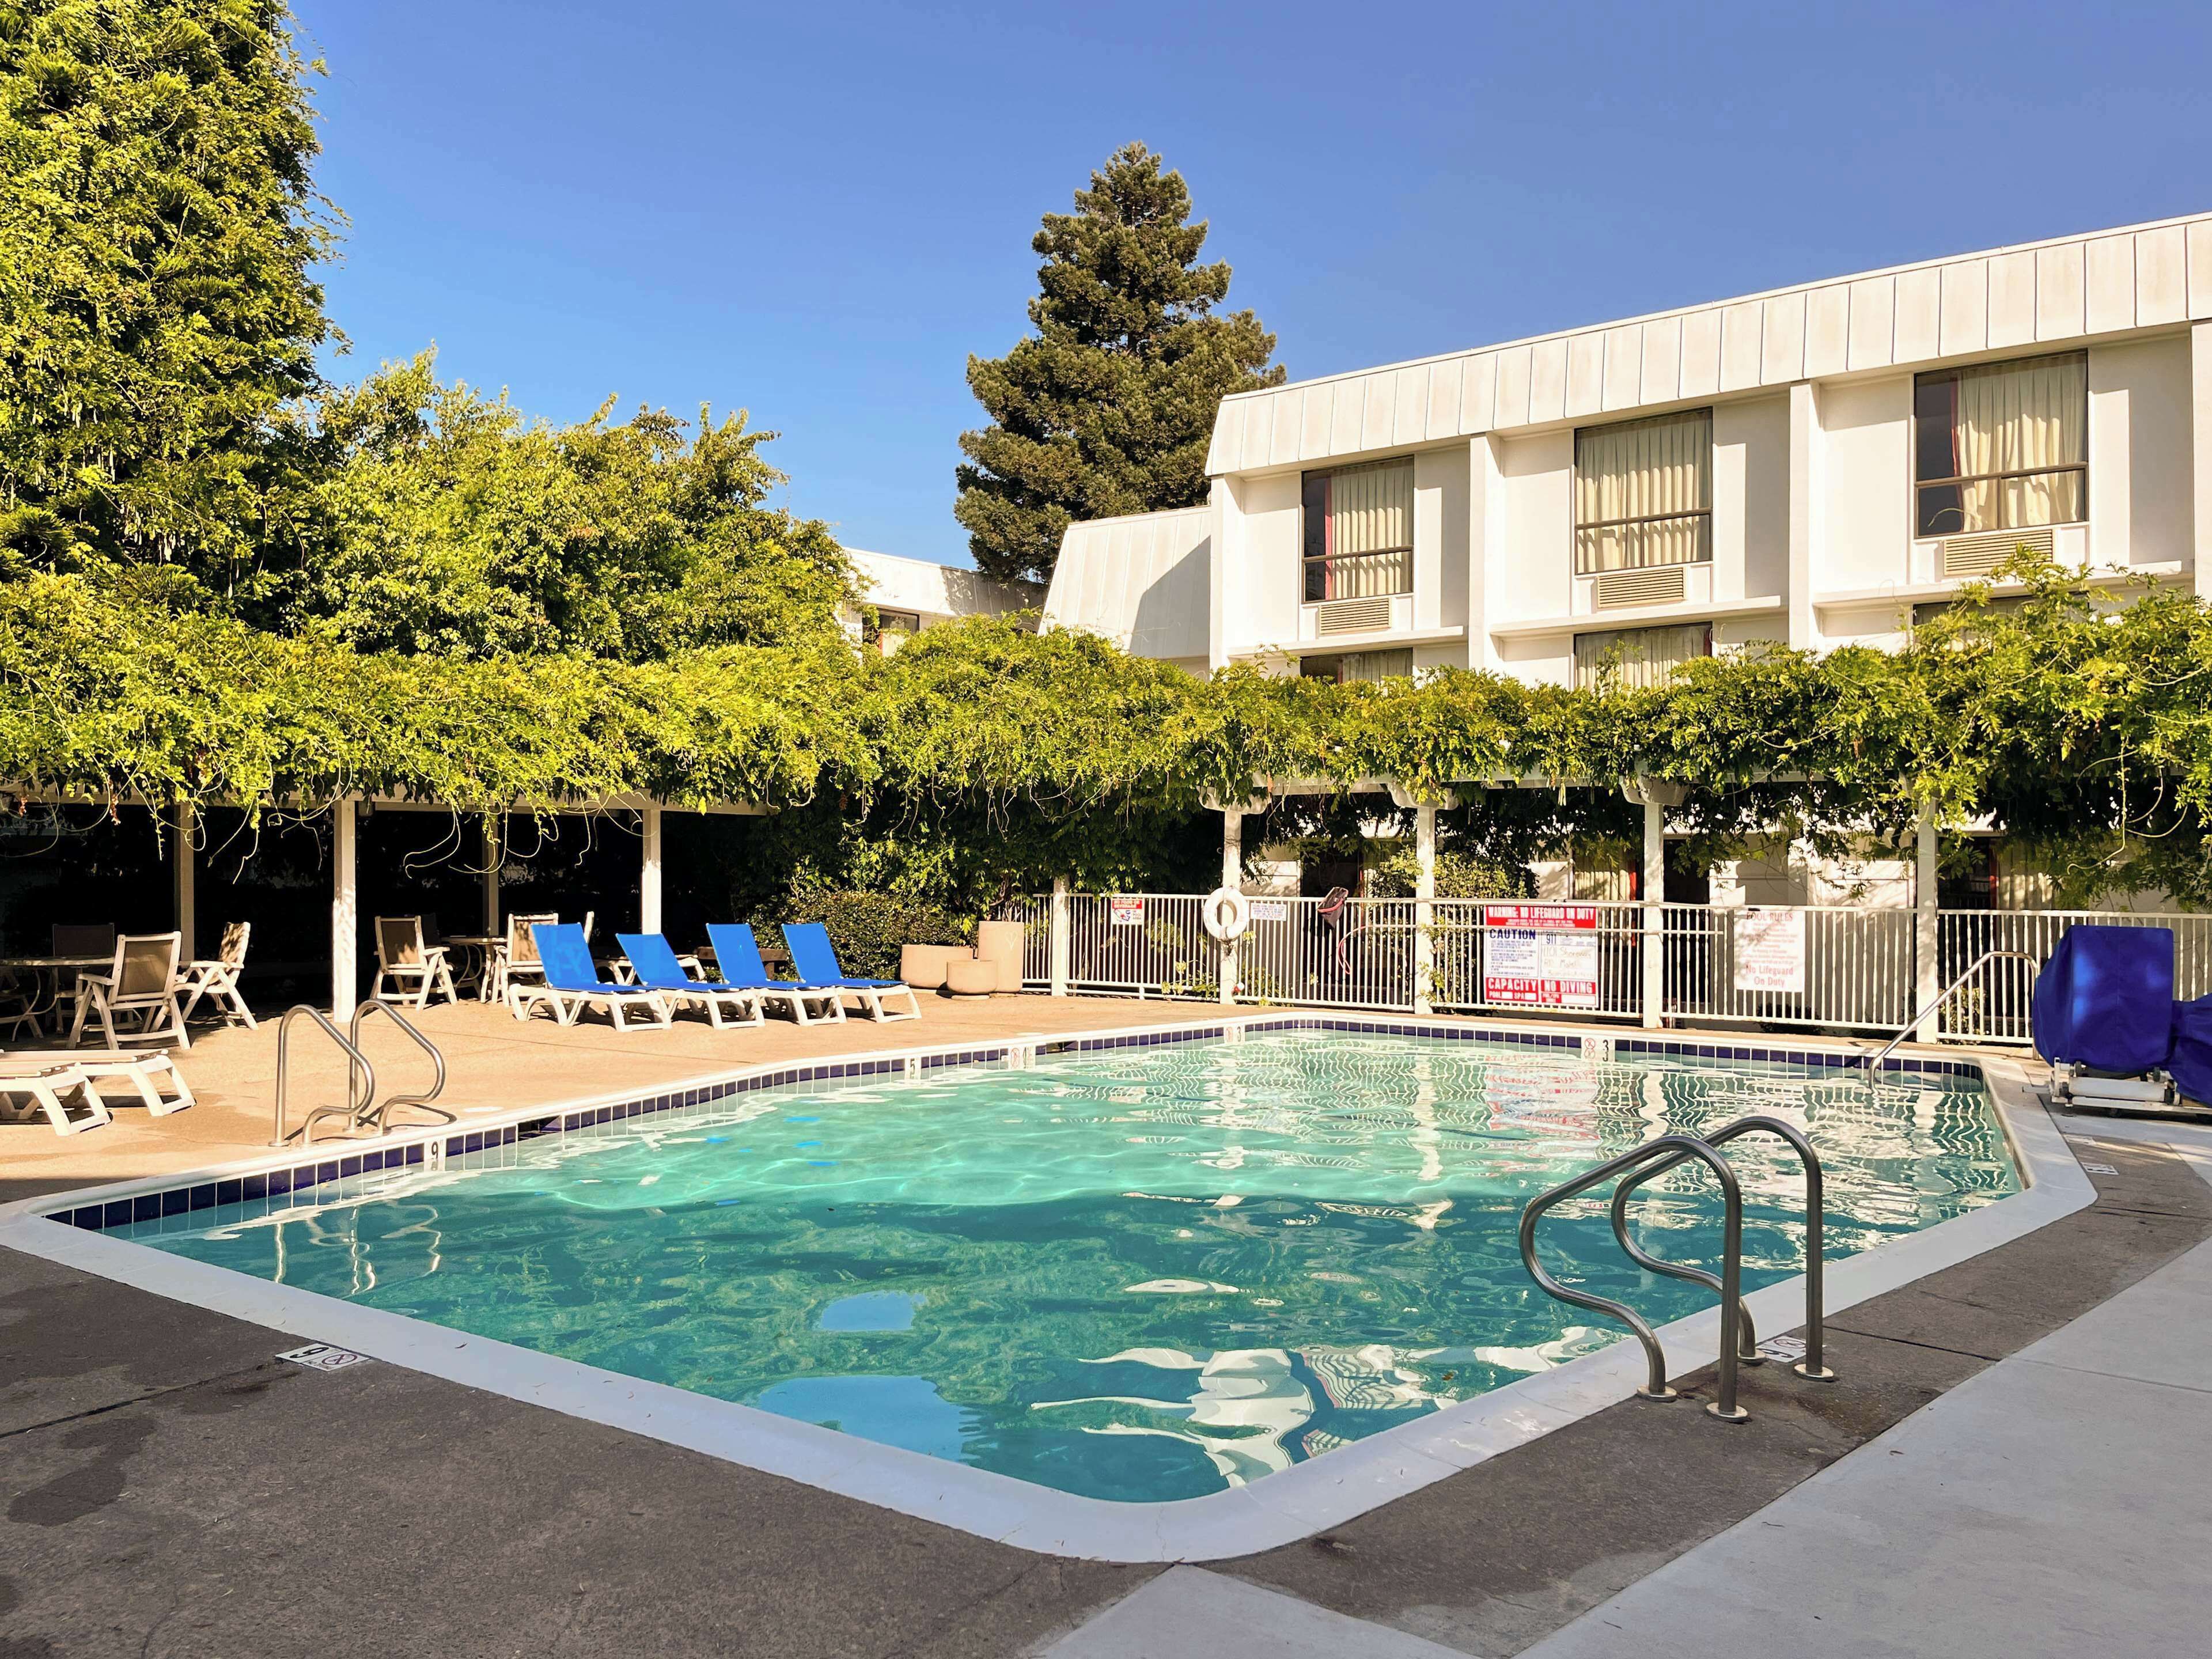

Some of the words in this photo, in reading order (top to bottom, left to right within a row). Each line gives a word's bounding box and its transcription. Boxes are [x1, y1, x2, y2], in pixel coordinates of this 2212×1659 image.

[1488, 906, 1519, 918] WARNING:
[1520, 906, 1529, 918] NO
[1530, 906, 1565, 920] LIFEGUARD
[1566, 907, 1575, 920] ON
[1577, 907, 1594, 920] DUTY
[1747, 912, 1767, 922] POOL
[1770, 912, 1793, 922] RULES
[1489, 929, 1536, 940] CAUTION
[1546, 933, 1556, 945] 911
[1746, 965, 1756, 974] No
[1759, 964, 1794, 976] Lifeguard
[1488, 978, 1537, 991] CAPACITY
[1544, 980, 1556, 992] NO
[1560, 980, 1593, 994] DIVING
[1754, 977, 1764, 985] On
[1768, 977, 1785, 987] Duty
[431, 1141, 438, 1159] 9
